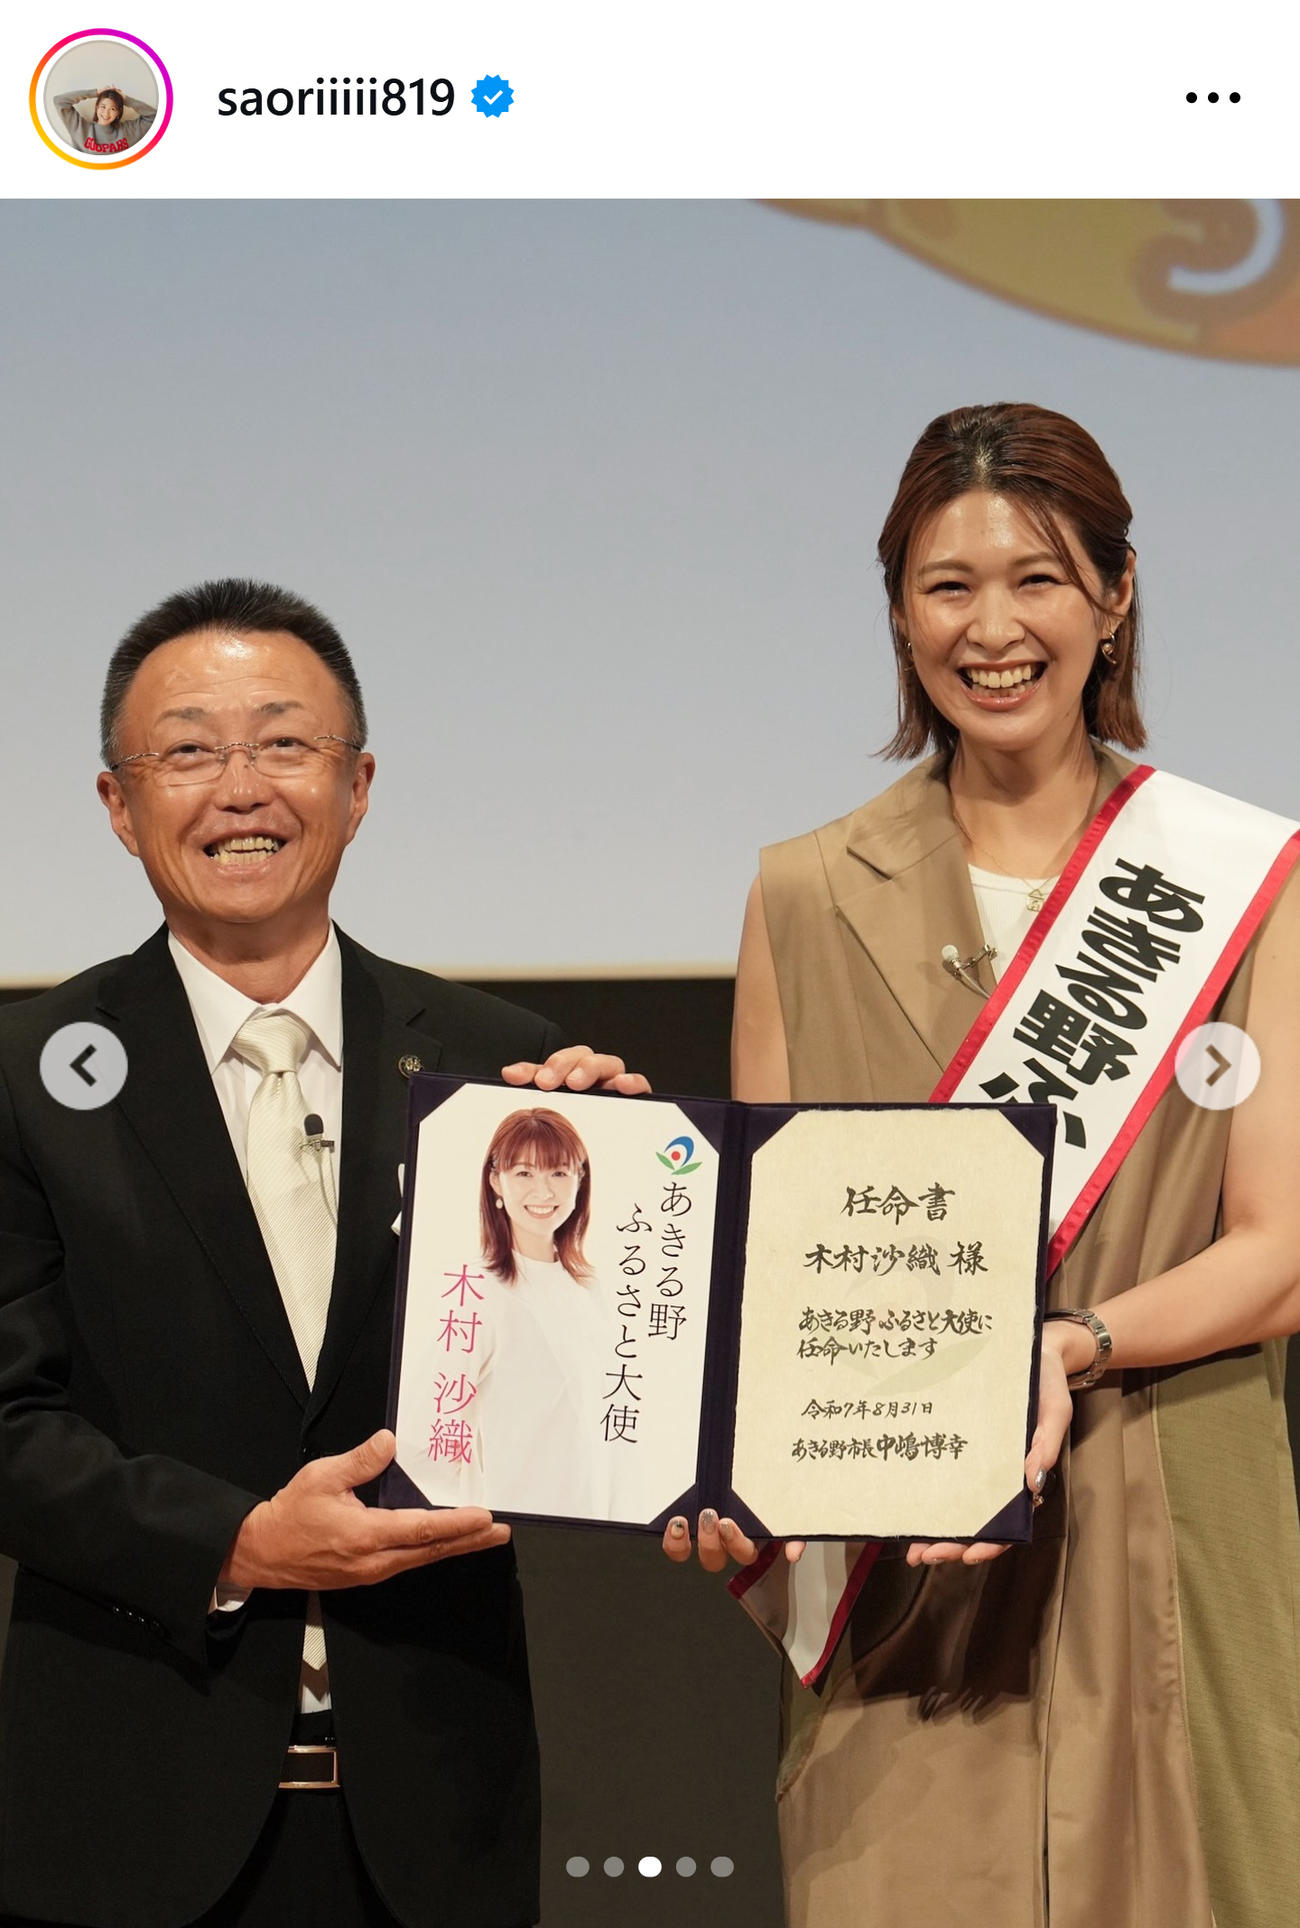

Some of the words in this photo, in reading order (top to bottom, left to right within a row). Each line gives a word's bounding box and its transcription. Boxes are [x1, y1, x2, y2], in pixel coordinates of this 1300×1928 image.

[841, 1182, 956, 1226] 任命書
[646, 1181, 693, 1341] あきる野
[599, 1203, 653, 1444] ふるさと大使
[797, 1336, 938, 1366] 任命いたします
[801, 1398, 933, 1420] 令和7年8月31日
